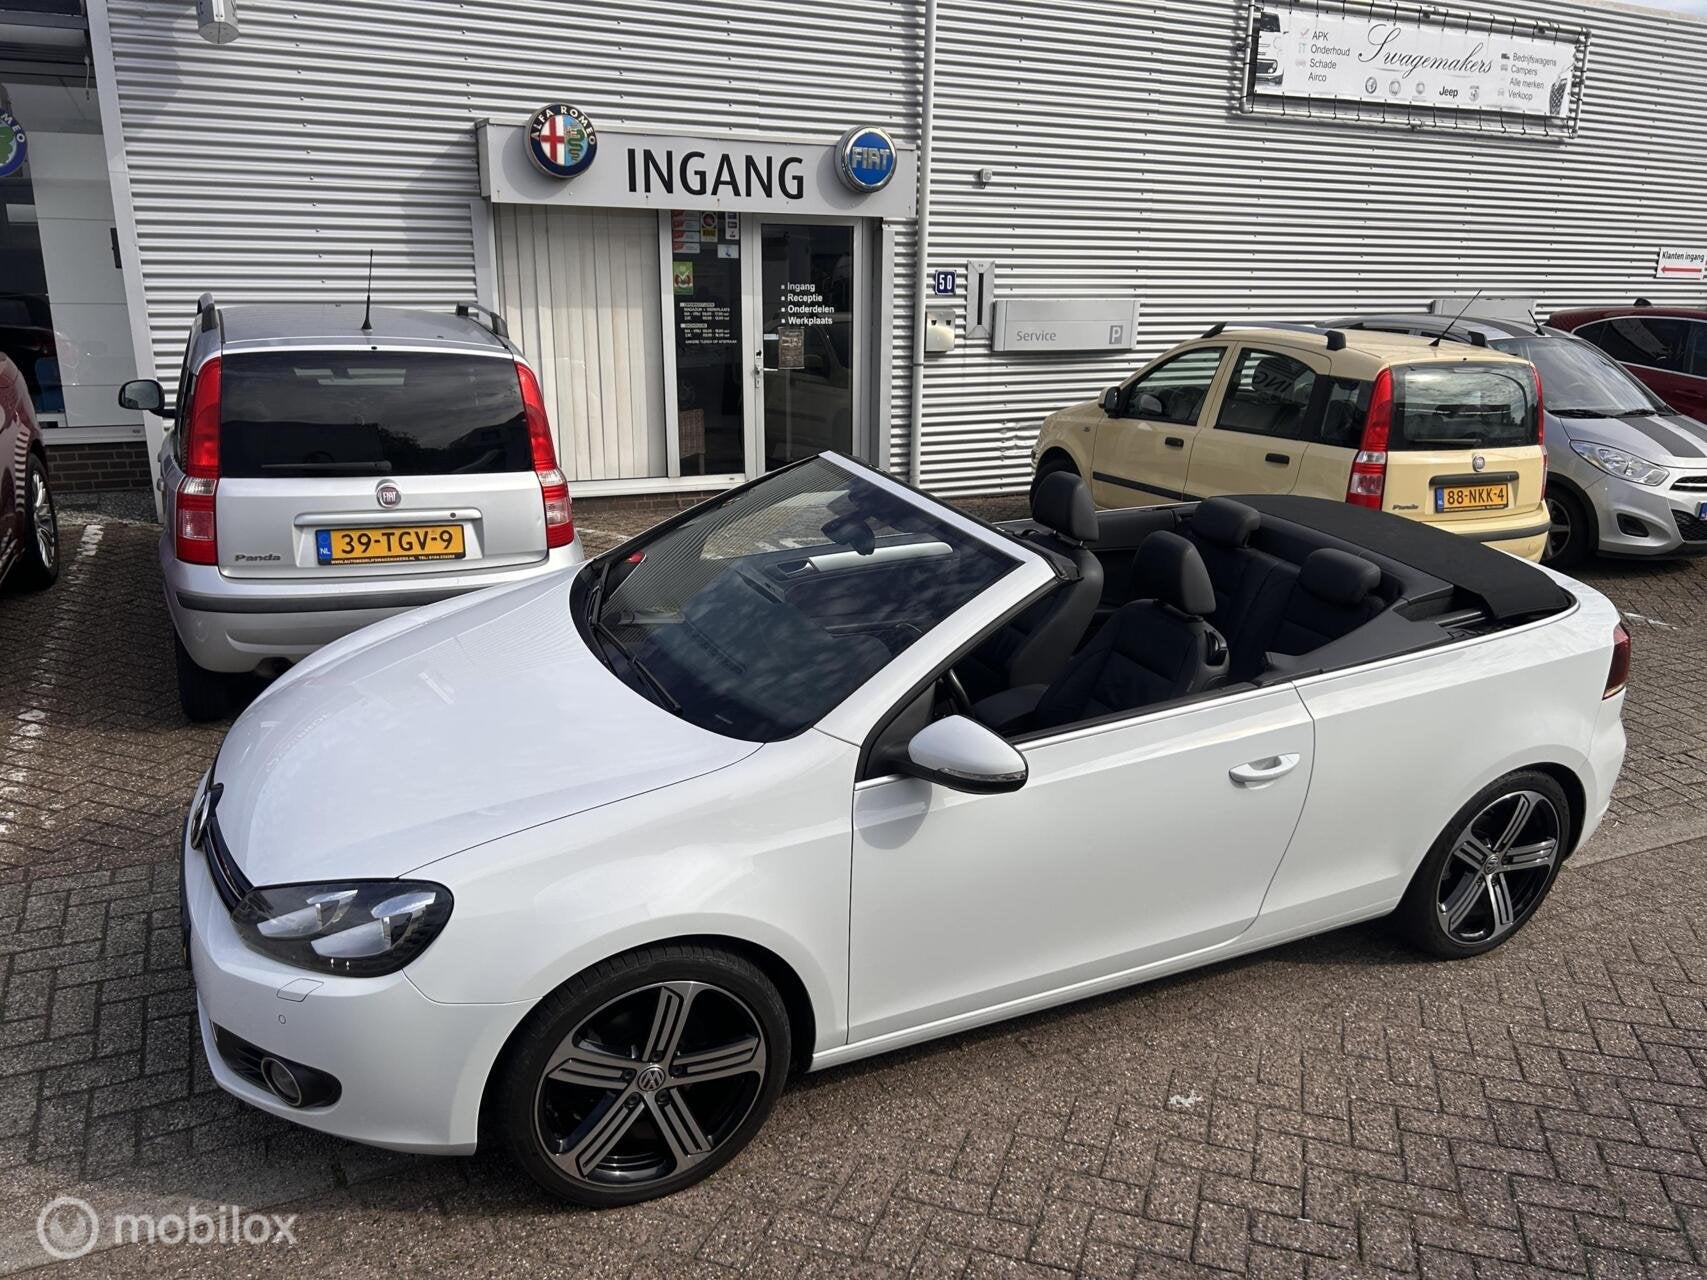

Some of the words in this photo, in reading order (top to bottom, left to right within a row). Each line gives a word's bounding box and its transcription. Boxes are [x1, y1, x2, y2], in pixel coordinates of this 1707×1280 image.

[1312, 31, 1329, 41] APK
[1310, 44, 1350, 56] Onderhoud
[1358, 23, 1493, 79] Swagemakers
[1310, 58, 1337, 69] Schade
[1512, 52, 1557, 67] Bedrijfswagens
[1510, 64, 1538, 77] Campers
[1308, 72, 1327, 82] Airco
[1509, 77, 1521, 88] Alle
[1522, 79, 1544, 89] merken
[1439, 86, 1458, 98] Jeep
[1508, 89, 1533, 101] Verkoop
[530, 109, 555, 141] ALFA
[560, 105, 596, 145] ROMEO
[852, 146, 890, 170] FIAT
[627, 148, 805, 200] INGANG
[1662, 250, 1684, 260] Klanten
[1685, 251, 1705, 263] ingang
[787, 282, 816, 293] Ingang
[939, 274, 953, 290] 50
[787, 293, 823, 304] Receptie
[787, 304, 835, 314] Onderdelen
[788, 316, 833, 326] Werkplaats
[1016, 330, 1057, 342] Service
[1111, 326, 1122, 342] P
[1447, 487, 1505, 505] 88-NKK-4
[341, 530, 454, 554] 39-TGV-9
[320, 547, 331, 555] NL
[235, 554, 281, 562] Panda
